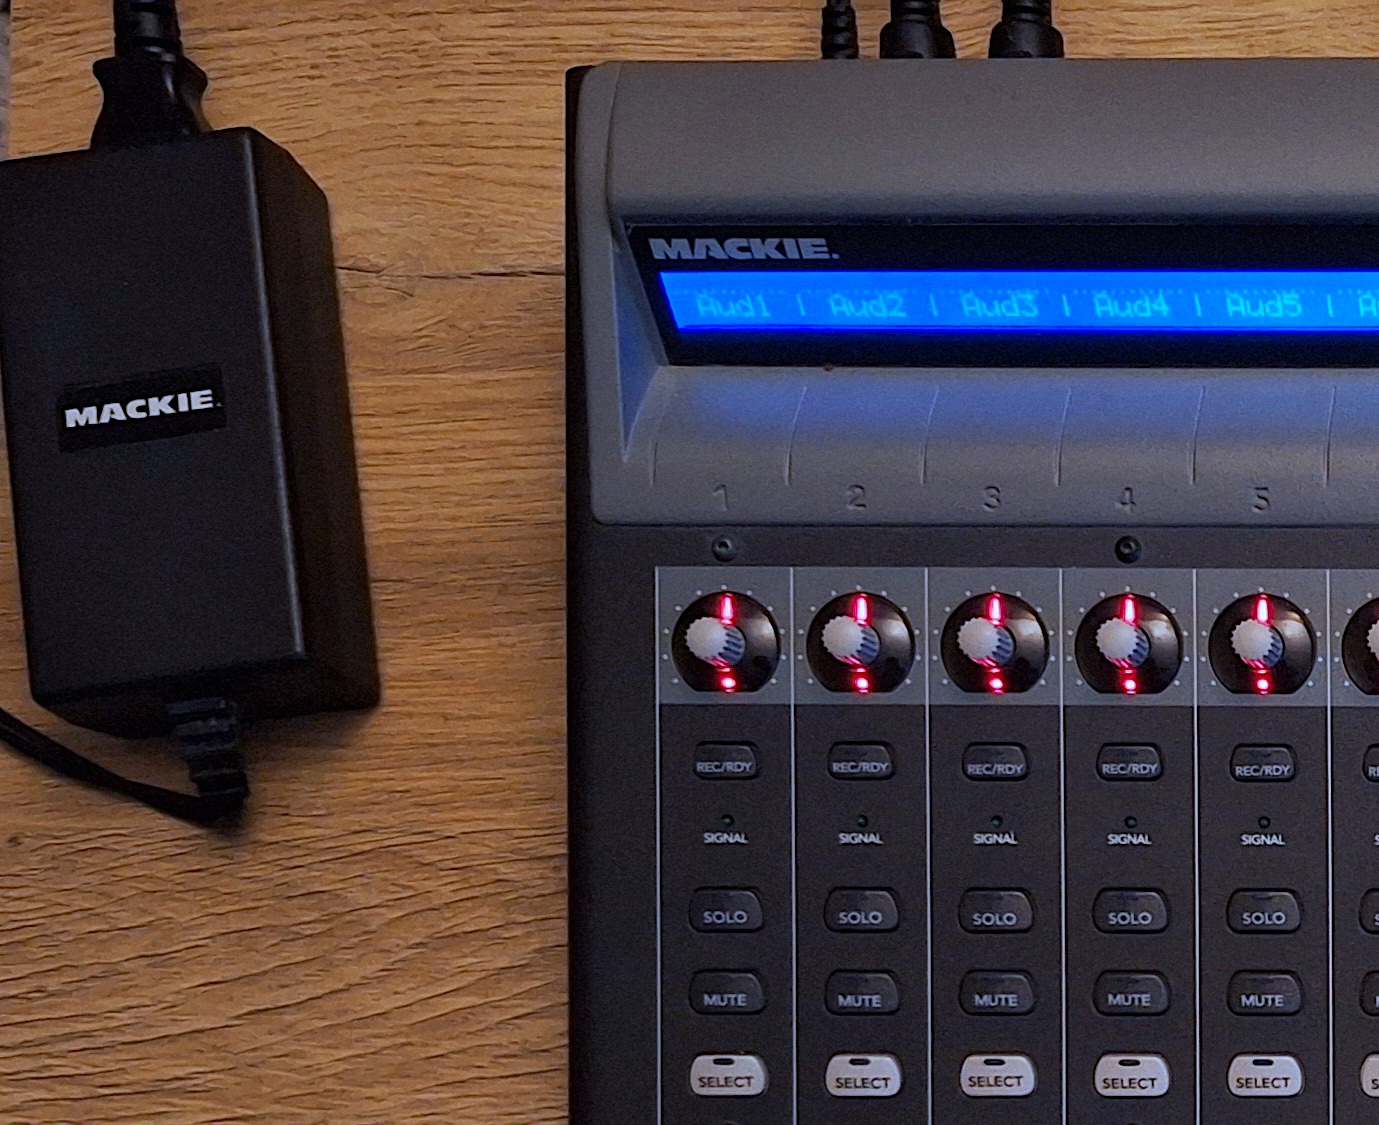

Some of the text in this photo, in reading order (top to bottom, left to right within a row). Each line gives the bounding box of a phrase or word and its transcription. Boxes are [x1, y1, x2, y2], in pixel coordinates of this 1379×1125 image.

[697, 761, 753, 773] REC/RDY
[832, 761, 889, 773] REC/RDY
[967, 763, 1024, 775] REC/RDY
[1102, 763, 1158, 775] REC/RDY
[1235, 765, 1291, 777] REC/RDY
[703, 832, 748, 845] SIGNAL
[838, 832, 883, 845] SIGNAL
[973, 833, 1018, 845] SIGNAL
[1107, 833, 1152, 845] SIGNAL
[1240, 834, 1285, 846] SIGNAL
[703, 911, 748, 924] SOLO
[839, 911, 883, 924] SOLO
[972, 913, 1017, 926] SOLO
[1108, 912, 1152, 925] SOLO
[1242, 911, 1286, 925] SOLO
[703, 994, 748, 1006] MUTE
[838, 995, 882, 1007] MUTE
[974, 994, 1018, 1006] MUTE
[1107, 994, 1151, 1006] MUTE
[1240, 995, 1285, 1007] MUTE
[698, 1075, 755, 1088] SELECT
[835, 1077, 892, 1089] SELECT
[968, 1075, 1024, 1087] SELECT
[1102, 1077, 1157, 1089] SELECT
[1236, 1077, 1291, 1089] SELECT
